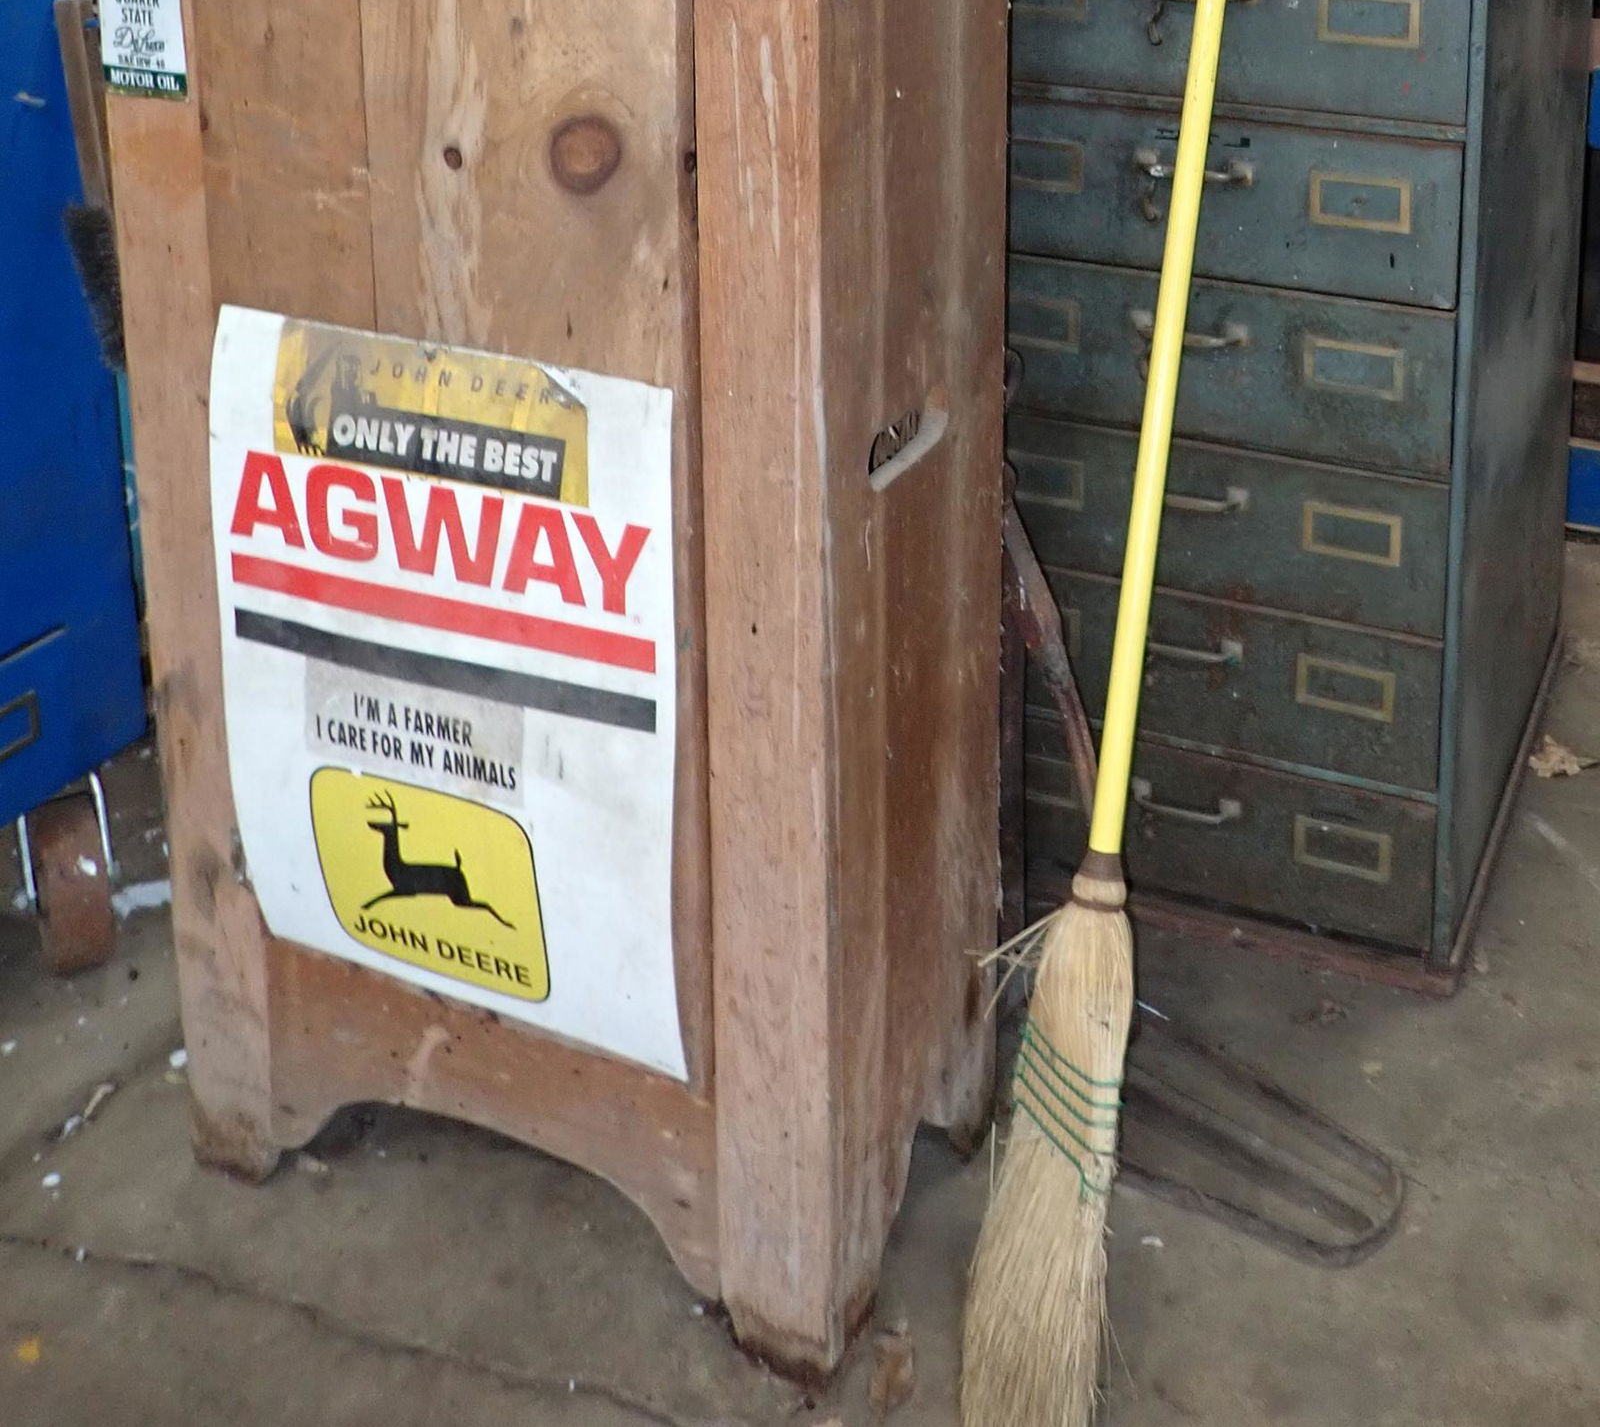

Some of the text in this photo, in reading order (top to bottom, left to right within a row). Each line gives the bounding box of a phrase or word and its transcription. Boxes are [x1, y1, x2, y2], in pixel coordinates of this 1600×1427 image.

[121, 7, 154, 27] STATE
[110, 67, 180, 91] MOTOR OIL
[370, 359, 568, 408] JOHN DEER
[332, 414, 559, 483] ONLY THE BEST
[230, 450, 653, 617] AGWAY
[354, 692, 473, 748] I'M A FARMER
[316, 714, 516, 791] I CARE FOR MY ANIMALS
[353, 913, 533, 988] JOHN DEERE
